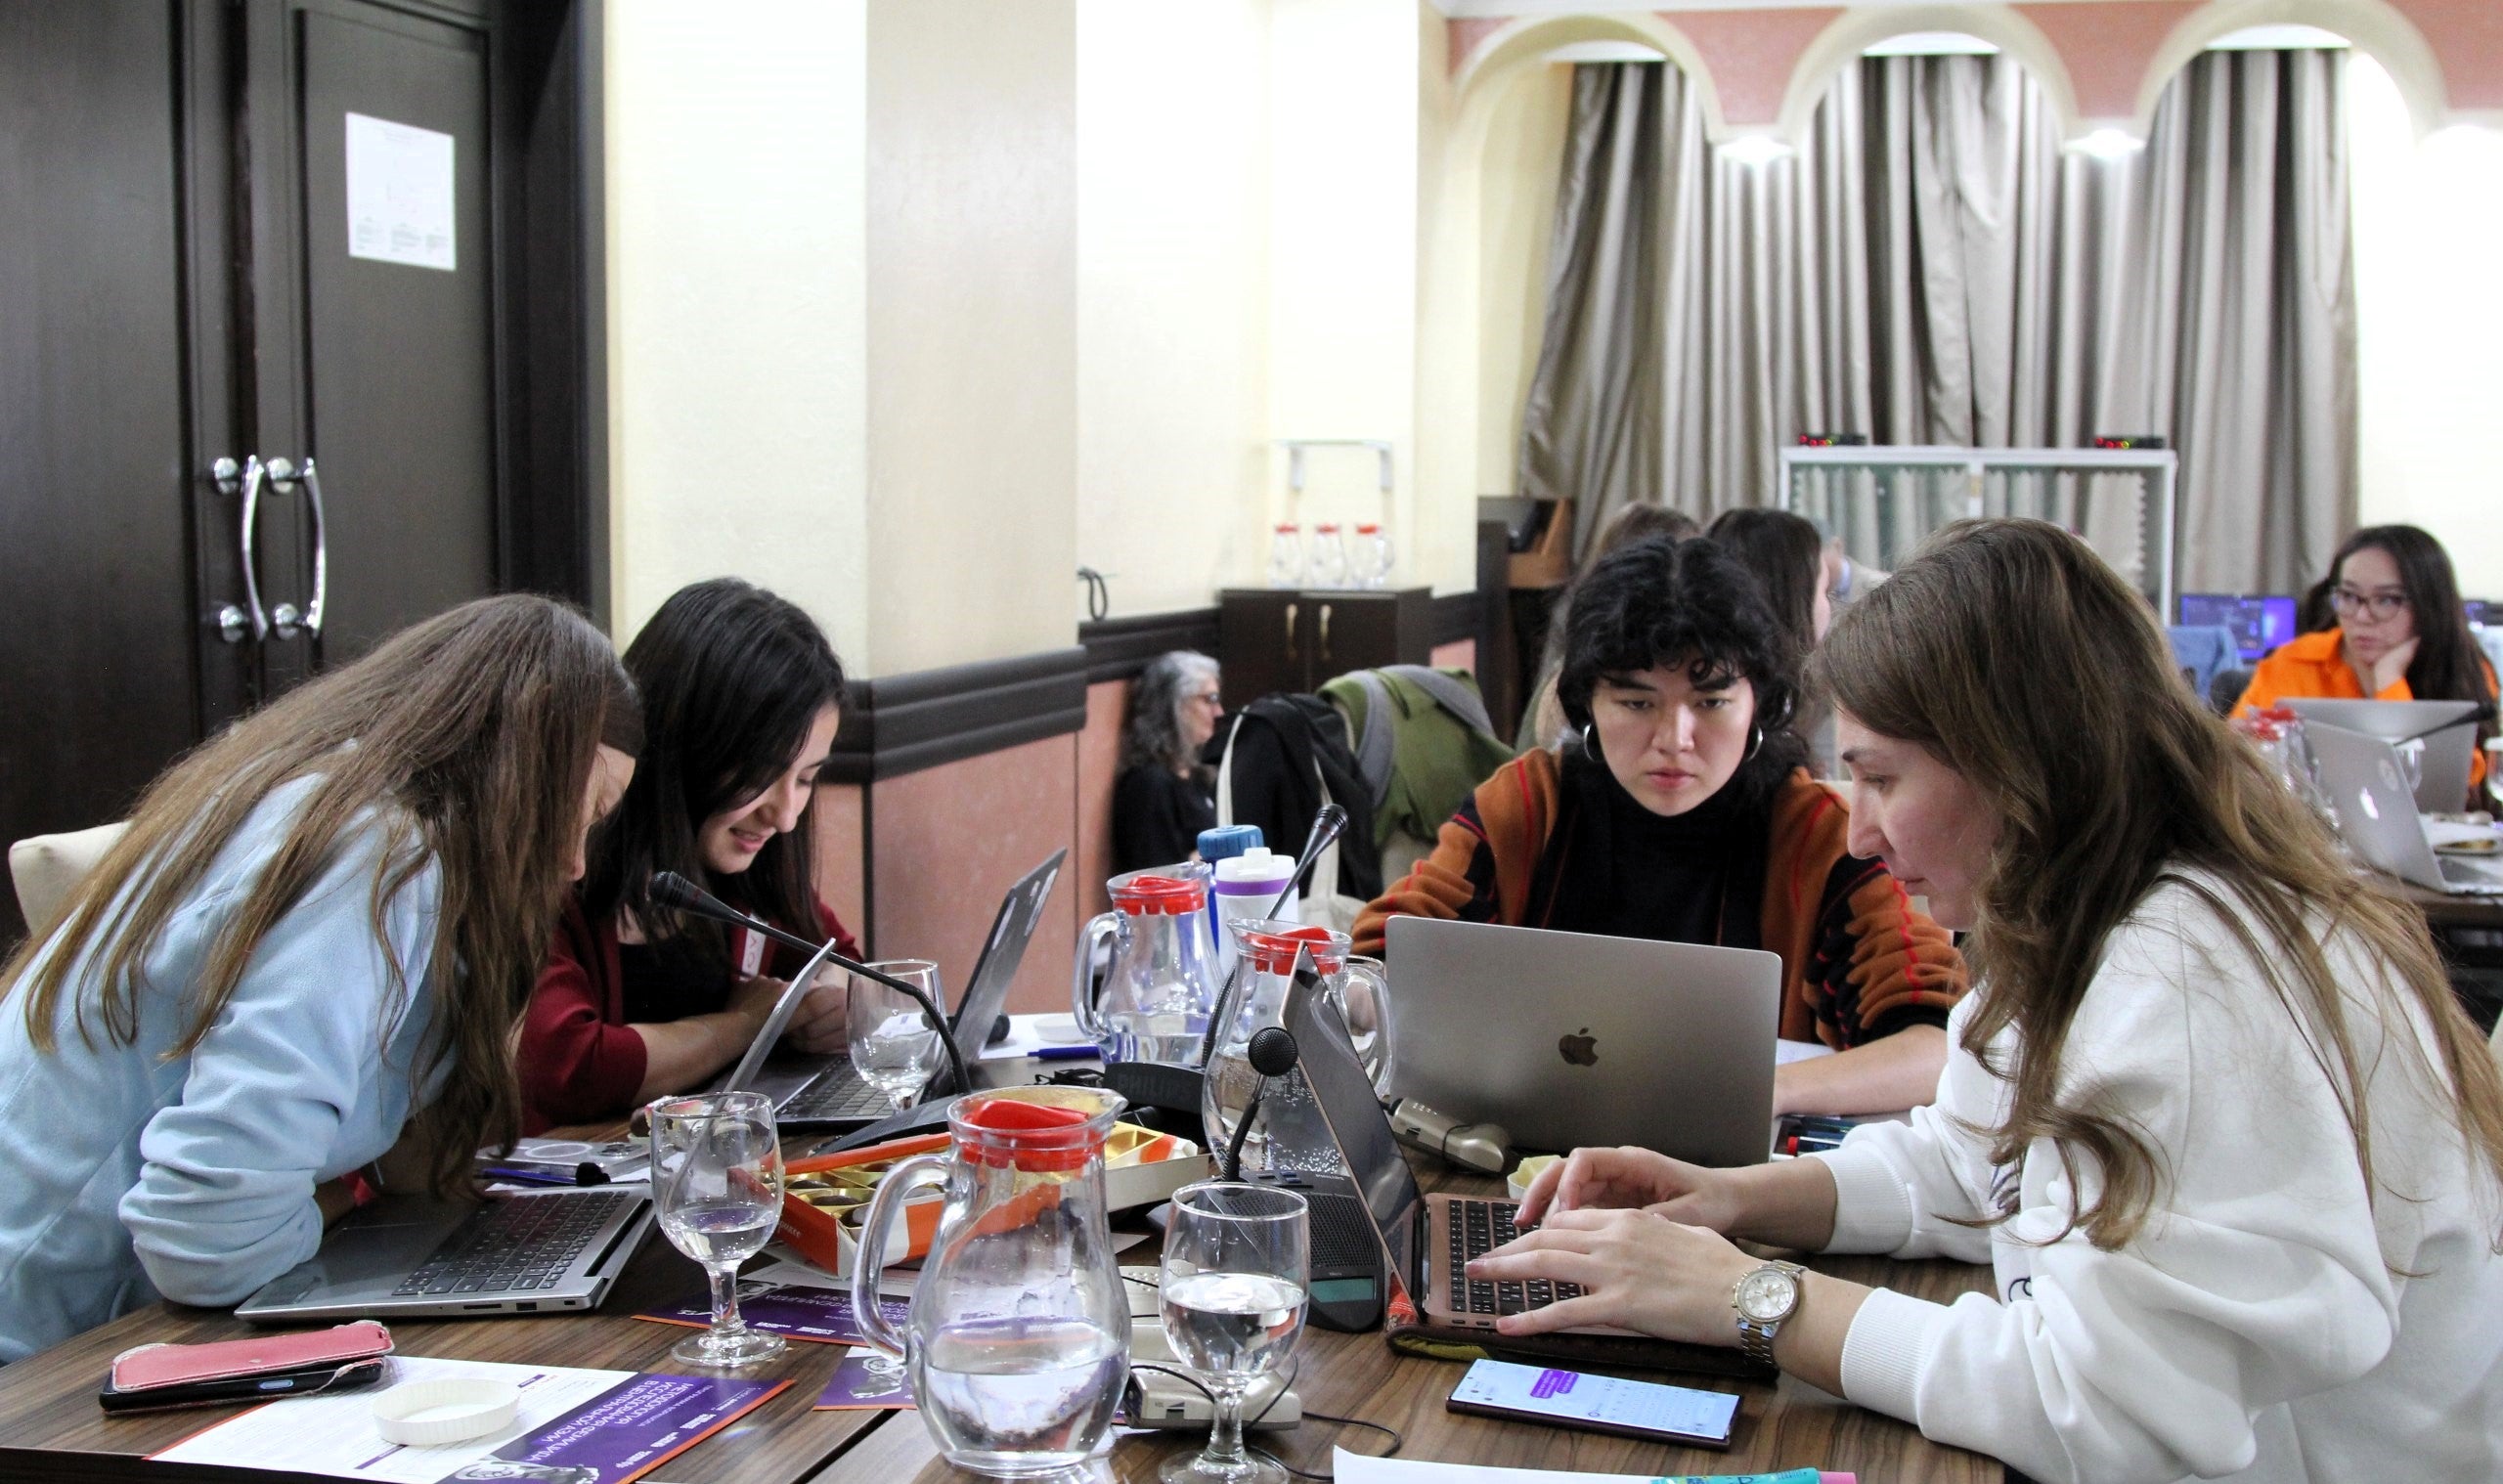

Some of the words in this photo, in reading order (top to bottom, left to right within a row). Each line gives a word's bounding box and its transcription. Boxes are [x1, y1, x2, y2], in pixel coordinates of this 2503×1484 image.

[573, 1383, 648, 1426] ЦЕНТРАЛЬНОЙ
[593, 1381, 678, 1427] ИССЛЕДОВАНИЯ
[615, 1382, 694, 1424] МЕТОДОЛОГИЯ
[526, 1423, 596, 1462] ФЕМИЦИДА
[541, 1423, 576, 1442] АЗИИ
